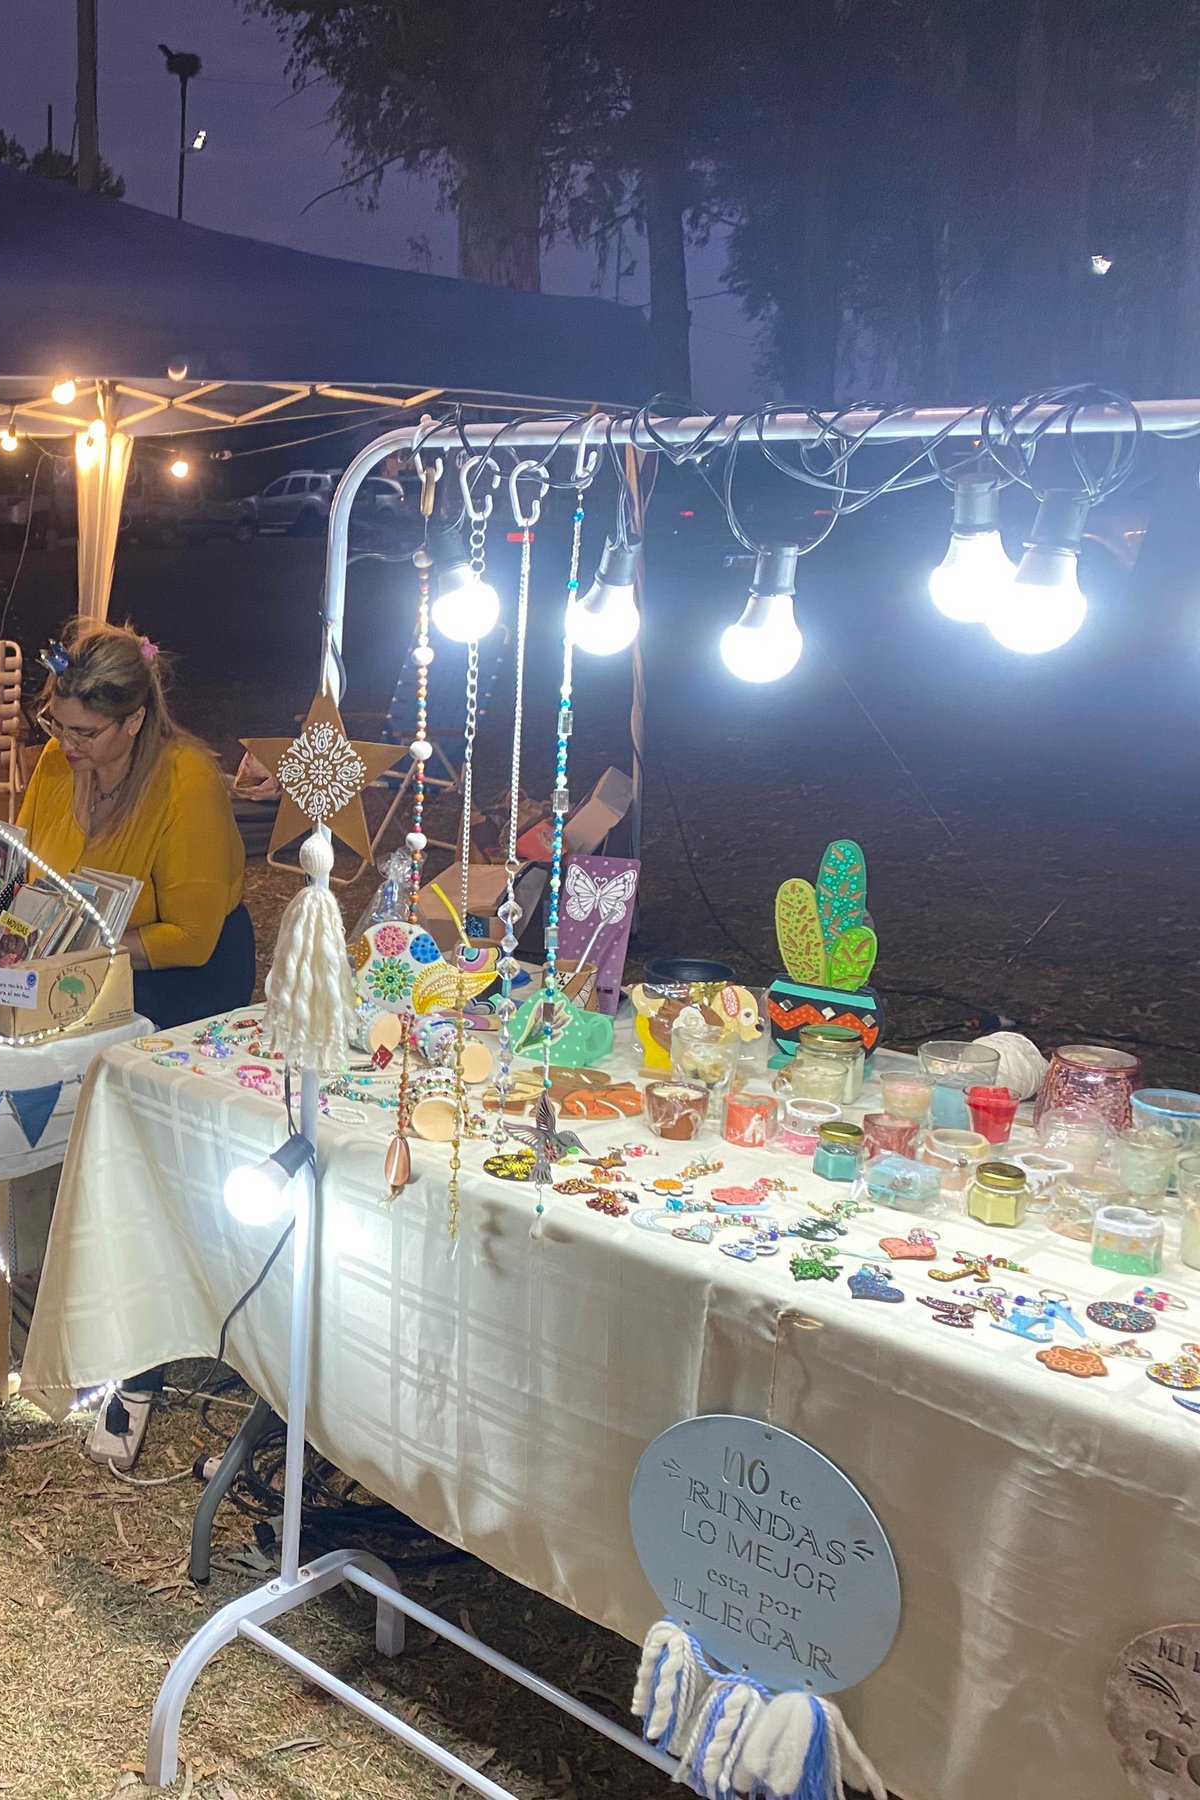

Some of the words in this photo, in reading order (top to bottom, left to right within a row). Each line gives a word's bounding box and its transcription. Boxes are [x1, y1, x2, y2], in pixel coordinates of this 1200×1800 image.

[6, 917, 29, 936] MOVIDAS
[55, 965, 87, 981] FINCA
[780, 1489, 801, 1511] te
[686, 1477, 847, 1566] RINDAS
[681, 1510, 717, 1544] LO
[727, 1531, 837, 1601] MEJOR
[707, 1568, 749, 1598] esta
[758, 1592, 802, 1622] por
[673, 1577, 839, 1680] LLEGAR
[1158, 1637, 1185, 1667] MI
